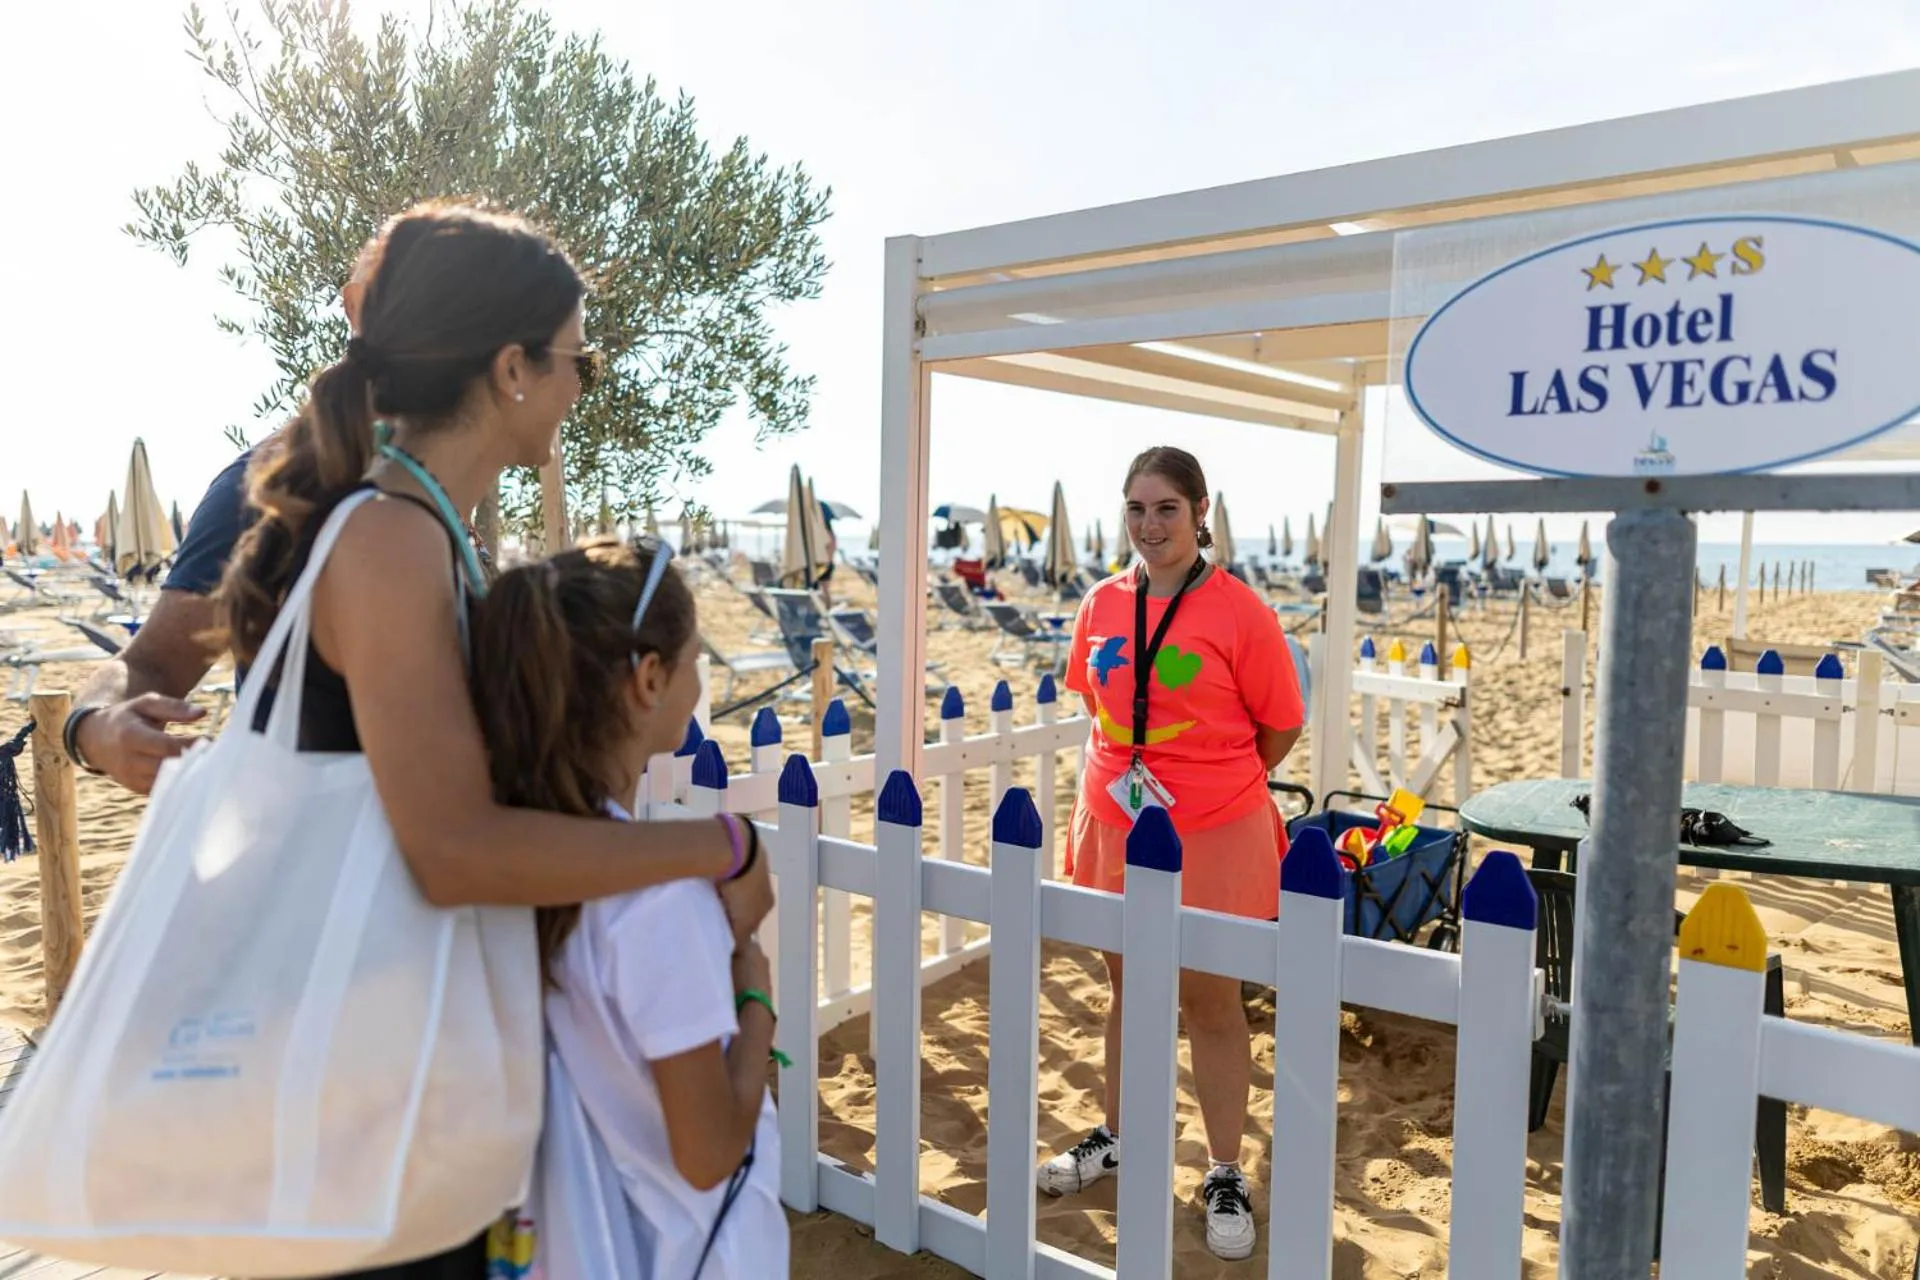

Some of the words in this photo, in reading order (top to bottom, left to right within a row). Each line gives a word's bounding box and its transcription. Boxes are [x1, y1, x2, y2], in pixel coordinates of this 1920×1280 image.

[1731, 236, 1765, 276] S
[1583, 293, 1735, 353] Hotel
[1507, 364, 1610, 417] LAS
[1626, 348, 1838, 412] VEGAS
